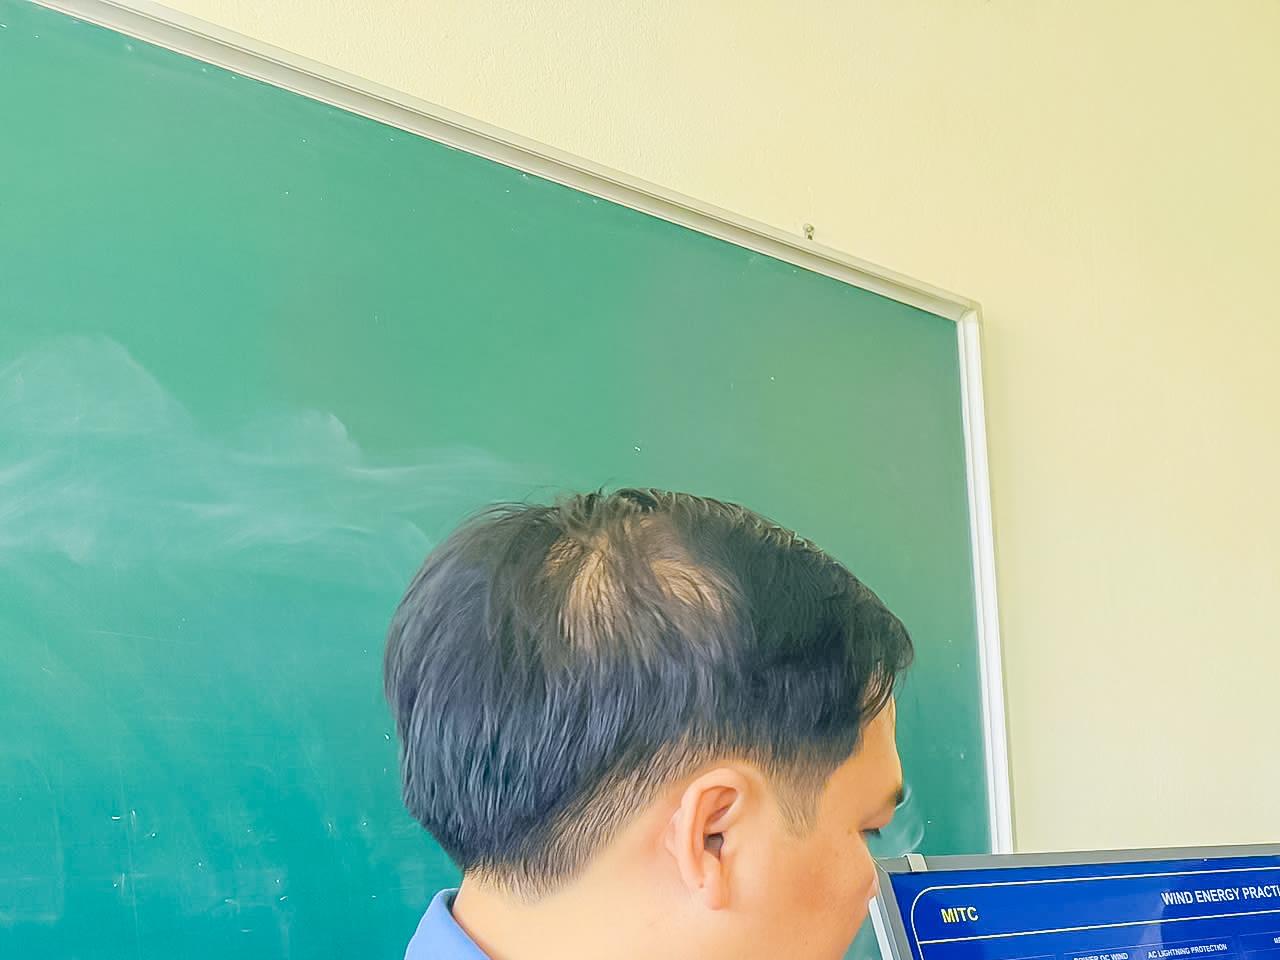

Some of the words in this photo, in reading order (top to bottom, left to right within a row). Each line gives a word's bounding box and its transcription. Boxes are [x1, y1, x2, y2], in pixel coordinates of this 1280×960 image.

[1161, 891, 1193, 906] WIND
[1196, 888, 1240, 903] ENERGY
[940, 906, 979, 923] MITC
[1112, 952, 1129, 960] WIND
[1148, 951, 1157, 959] AC
[1158, 948, 1190, 957] LIGHTNING
[1191, 943, 1228, 954] PROTECTION
